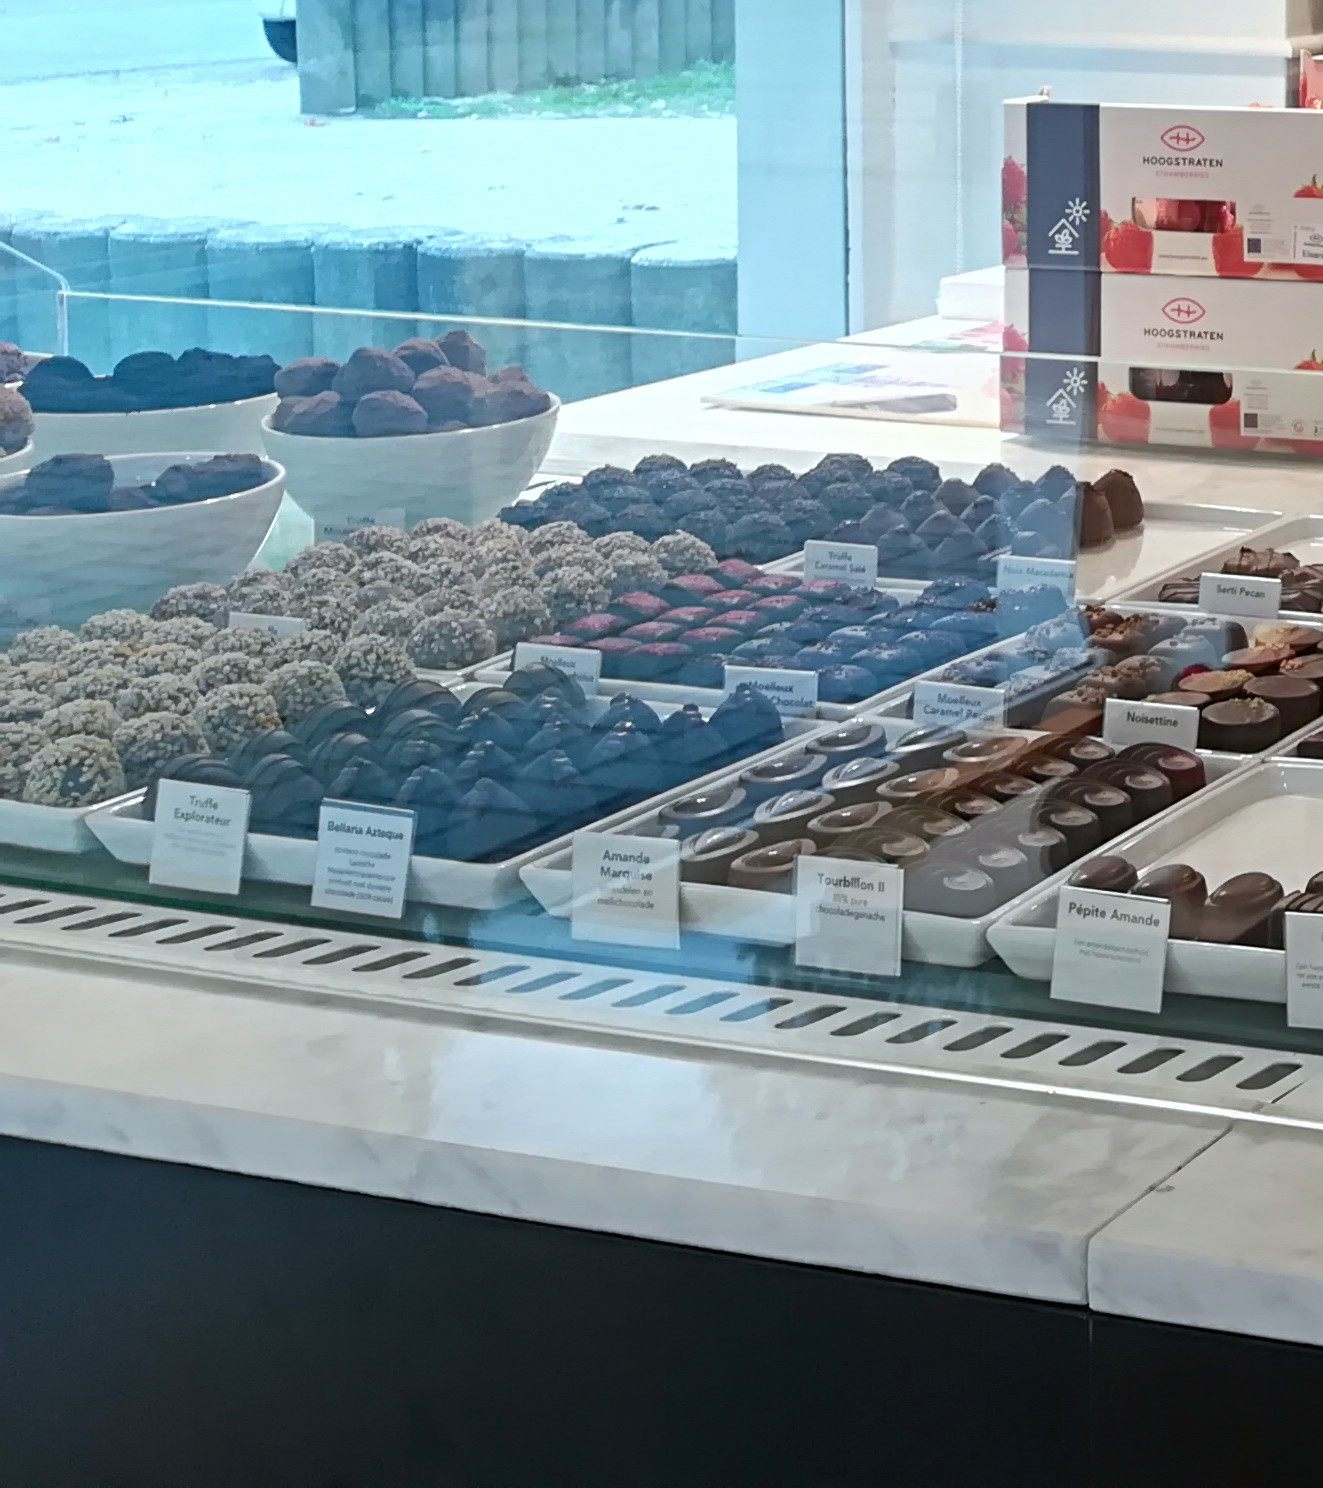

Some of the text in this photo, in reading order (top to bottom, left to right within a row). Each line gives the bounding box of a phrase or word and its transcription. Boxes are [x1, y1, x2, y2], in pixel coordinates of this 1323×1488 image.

[1142, 156, 1224, 168] HOOGSTRATEN
[1144, 328, 1224, 341] HOOGSTRATEN
[1216, 584, 1266, 599] Serti Pecan
[937, 693, 981, 707] Moelleux
[923, 704, 964, 719] Caramel
[1126, 711, 1179, 728] Noisettine
[189, 795, 219, 811] Truffe
[174, 808, 231, 827] Explorateur
[365, 825, 404, 842] Azteque
[817, 872, 874, 891] Tourbillon
[1068, 901, 1160, 928] Pépite Amande
